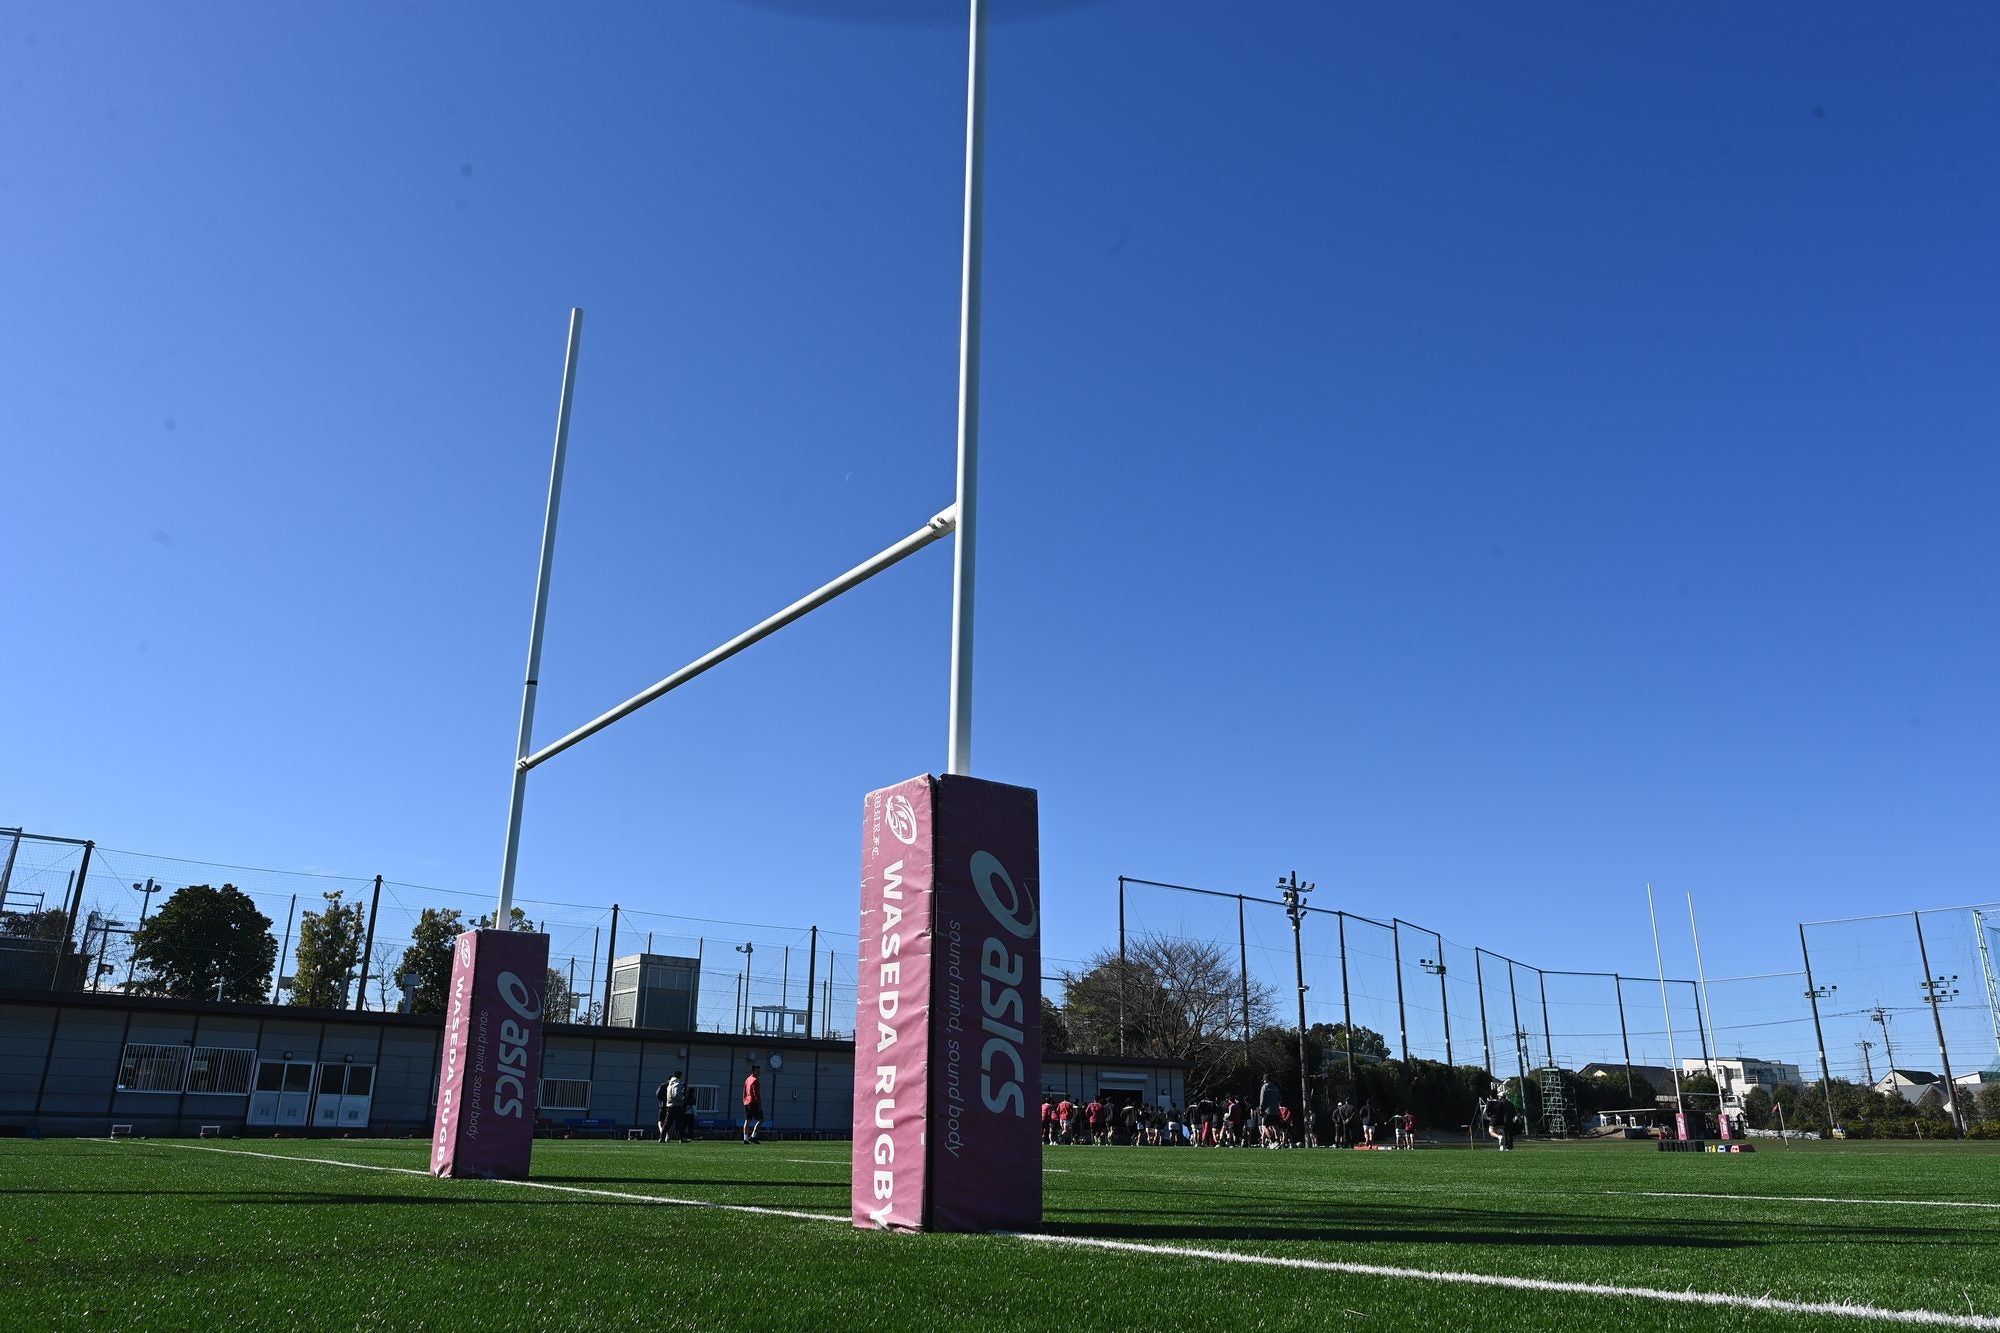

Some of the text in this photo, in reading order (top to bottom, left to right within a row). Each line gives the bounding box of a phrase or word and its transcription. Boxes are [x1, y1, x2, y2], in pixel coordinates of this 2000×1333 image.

[434, 977, 465, 1177] WASEDA RUGBY
[467, 1010, 489, 1140] sound mind, sound body
[494, 1019, 529, 1119] asics
[870, 859, 905, 1230] WASEDA RUGBY
[945, 920, 964, 1157] sound mind, sound body
[981, 937, 1025, 1118] asics
